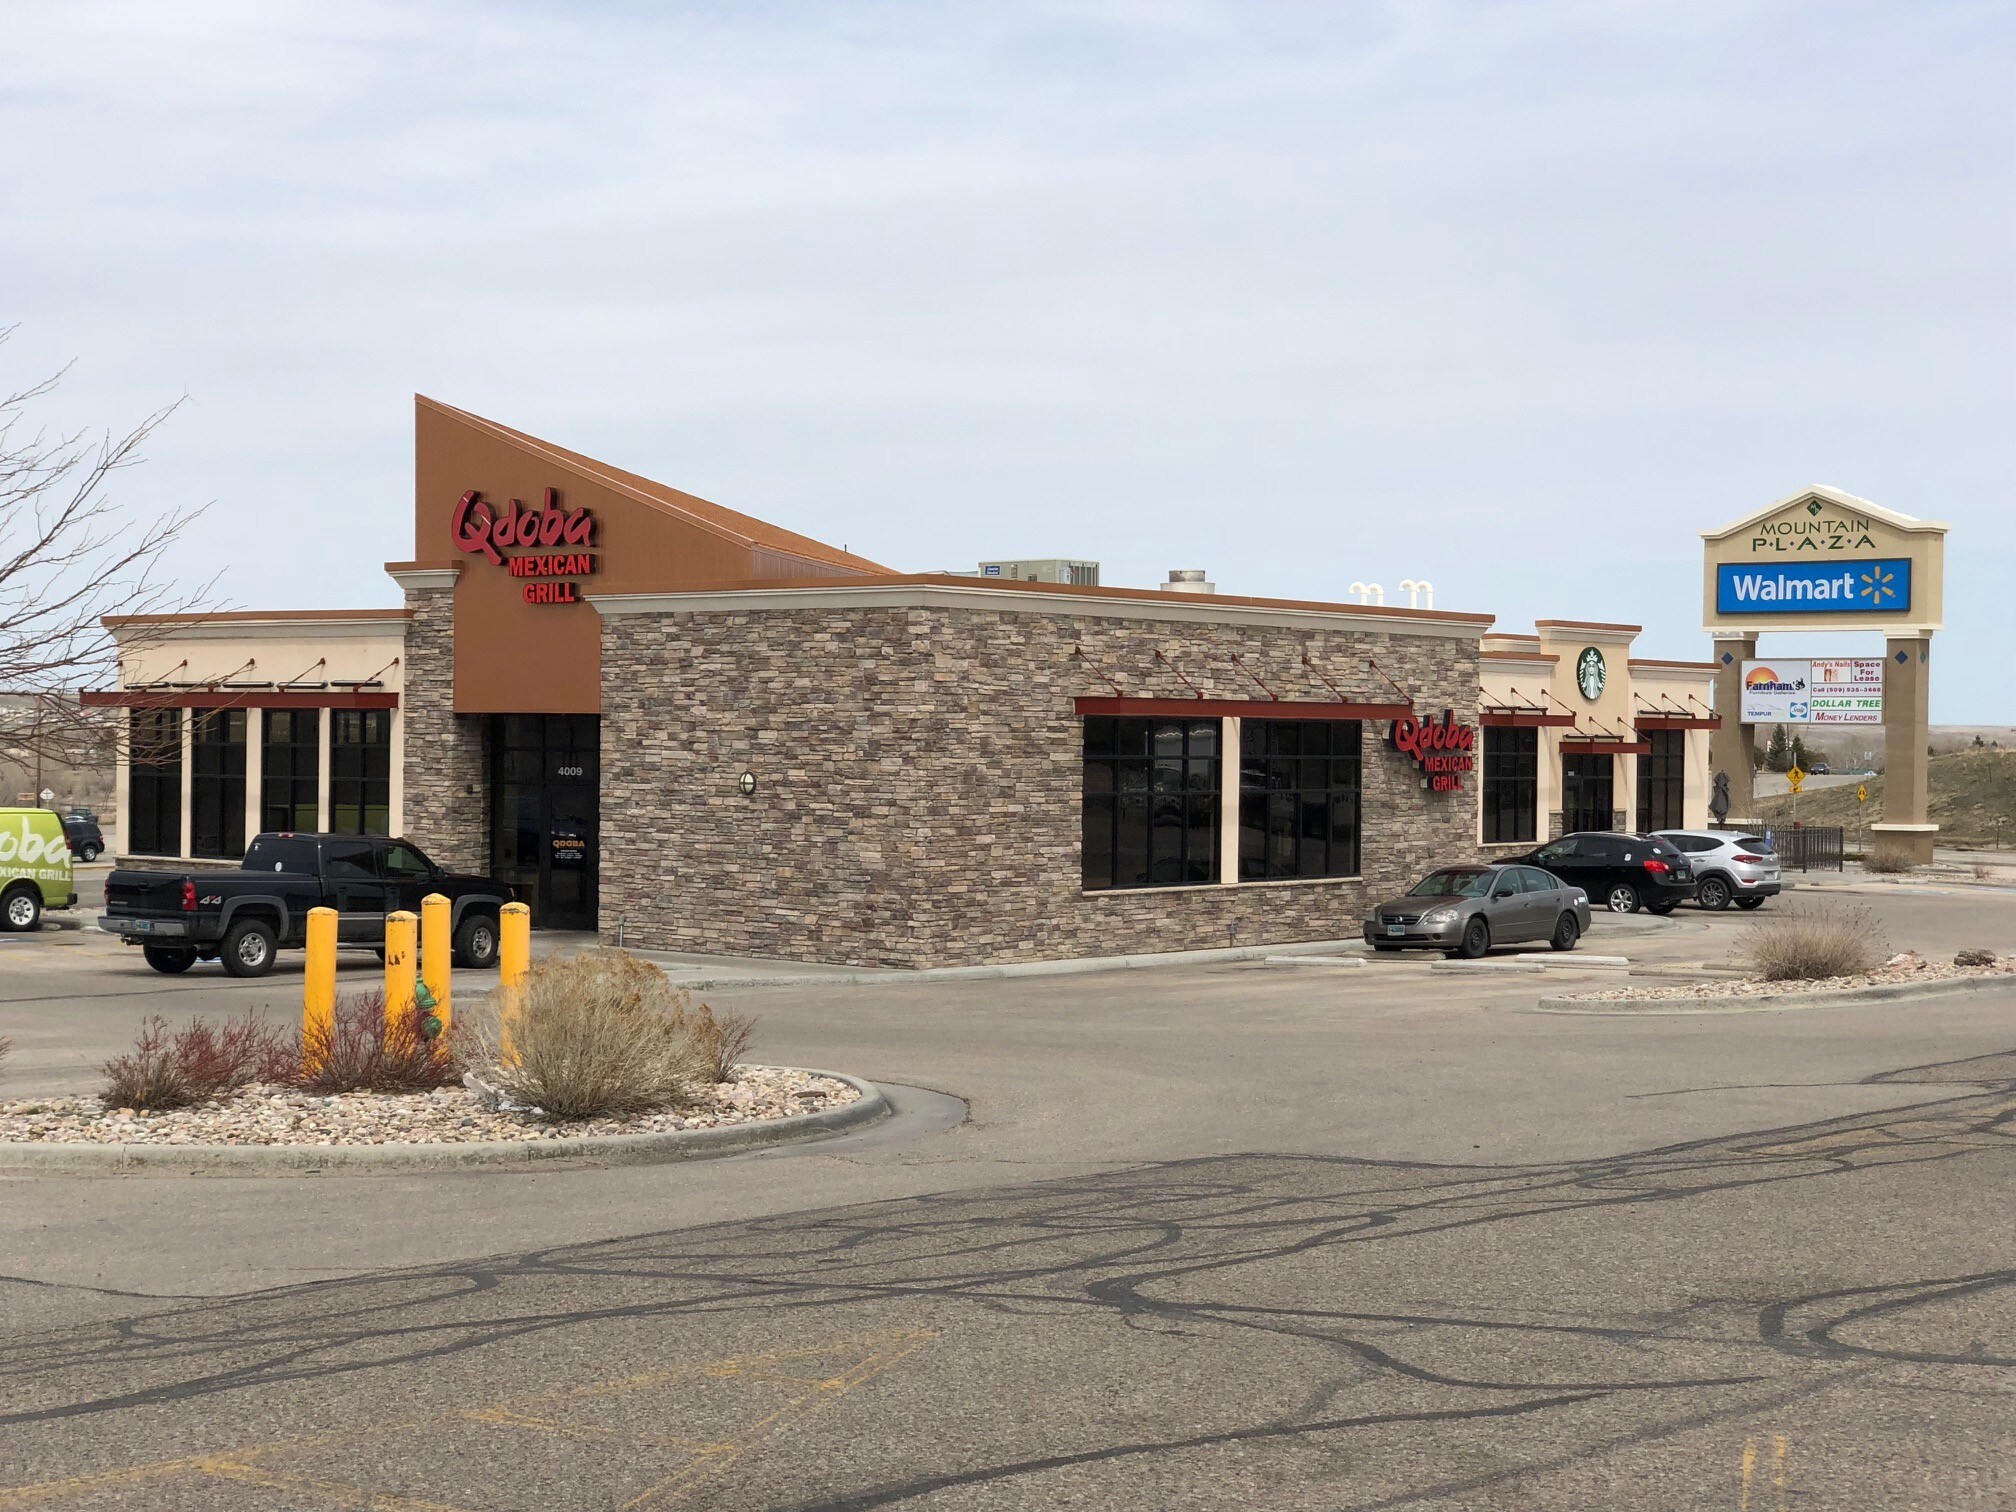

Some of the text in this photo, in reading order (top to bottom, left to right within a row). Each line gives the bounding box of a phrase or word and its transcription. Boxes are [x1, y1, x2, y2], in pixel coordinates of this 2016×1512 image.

[452, 486, 595, 566] Qdoba
[1760, 520, 1869, 535] MOUNTAIN
[509, 554, 593, 577] MEXICAN
[523, 583, 576, 604] GRILL
[1733, 573, 1854, 601] Walmart
[1746, 680, 1802, 691] Farnham's
[1815, 712, 1878, 721] MONEY LENDERS
[1394, 708, 1475, 761] Qdoba
[558, 767, 583, 776] 4009
[1424, 756, 1474, 772] MEXICAN
[1433, 776, 1465, 791] GRILL
[552, 840, 585, 849] QDOBA
[38, 869, 71, 881] GRILL
